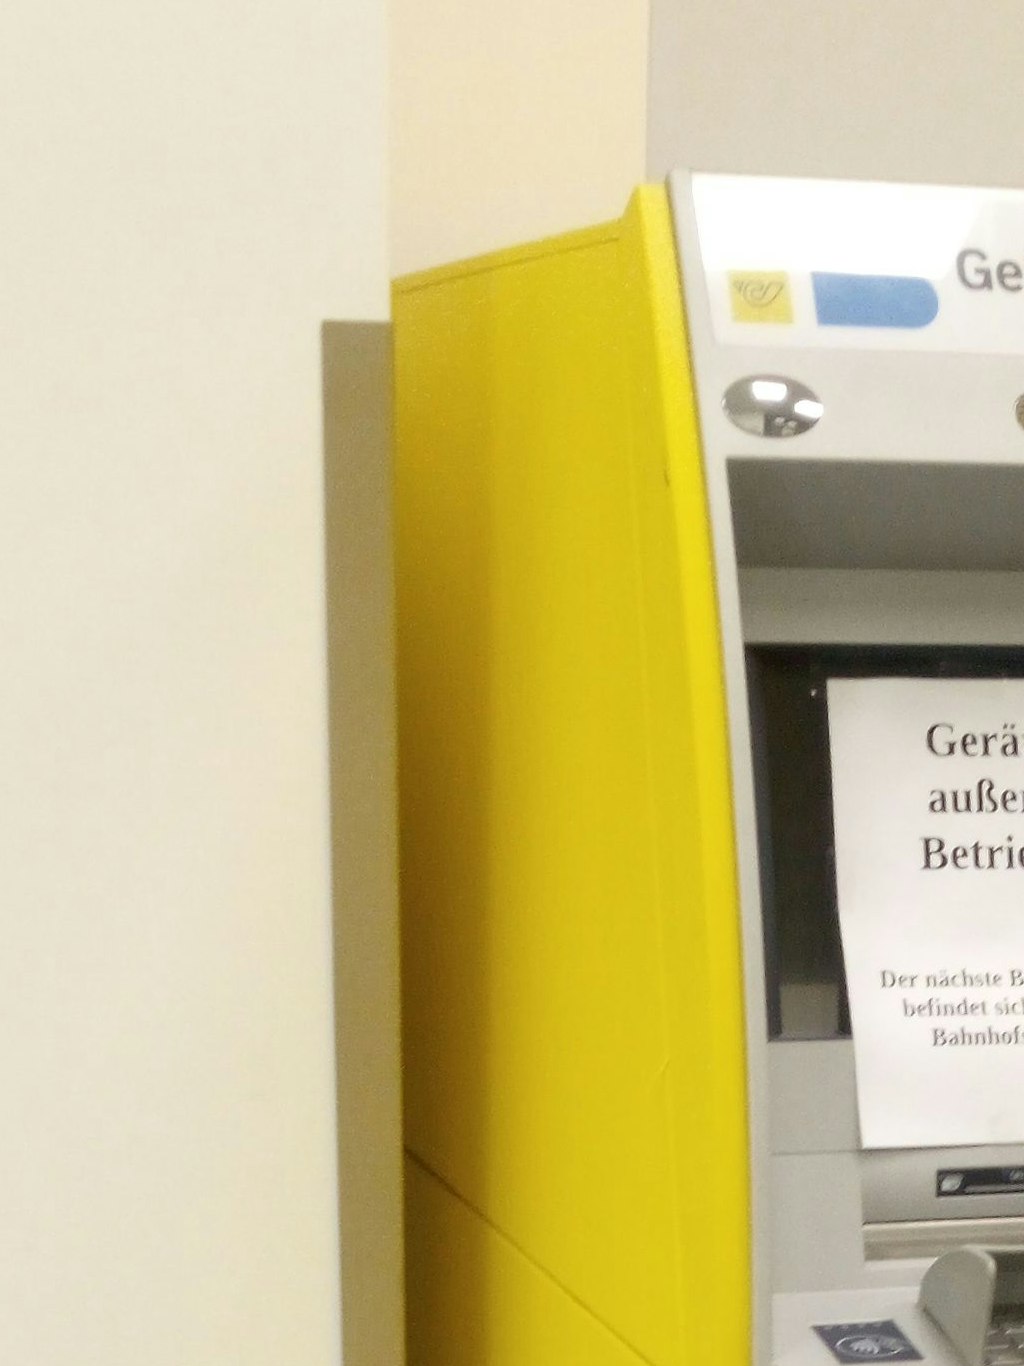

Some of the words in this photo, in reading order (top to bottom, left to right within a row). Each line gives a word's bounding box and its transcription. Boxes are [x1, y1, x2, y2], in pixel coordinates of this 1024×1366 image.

[880, 968, 918, 989] Der
[925, 968, 1002, 989] nächste
[903, 998, 988, 1018] befindet
